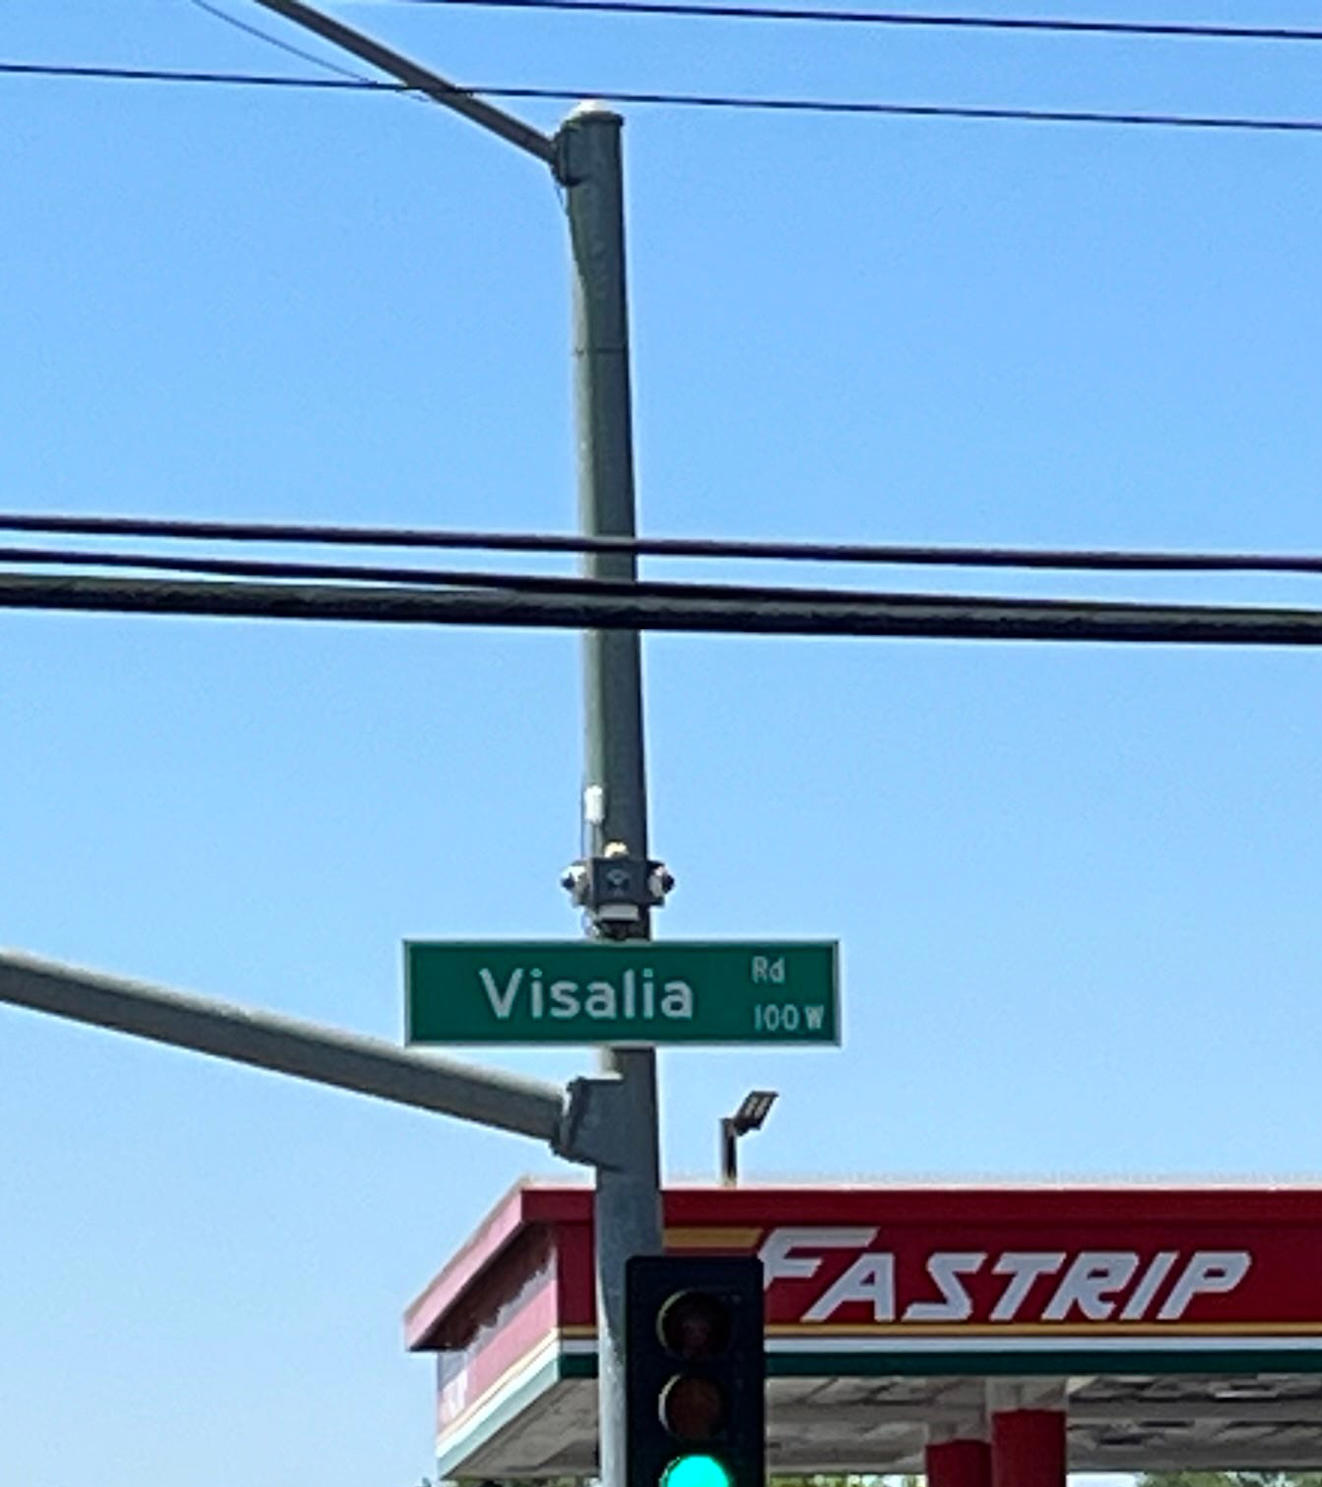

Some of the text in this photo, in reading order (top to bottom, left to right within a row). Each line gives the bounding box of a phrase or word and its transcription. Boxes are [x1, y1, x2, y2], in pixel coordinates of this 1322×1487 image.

[478, 956, 785, 1020] Visalia Rd
[754, 1005, 824, 1031] 100 W
[758, 1227, 1252, 1322] FASTRIP
